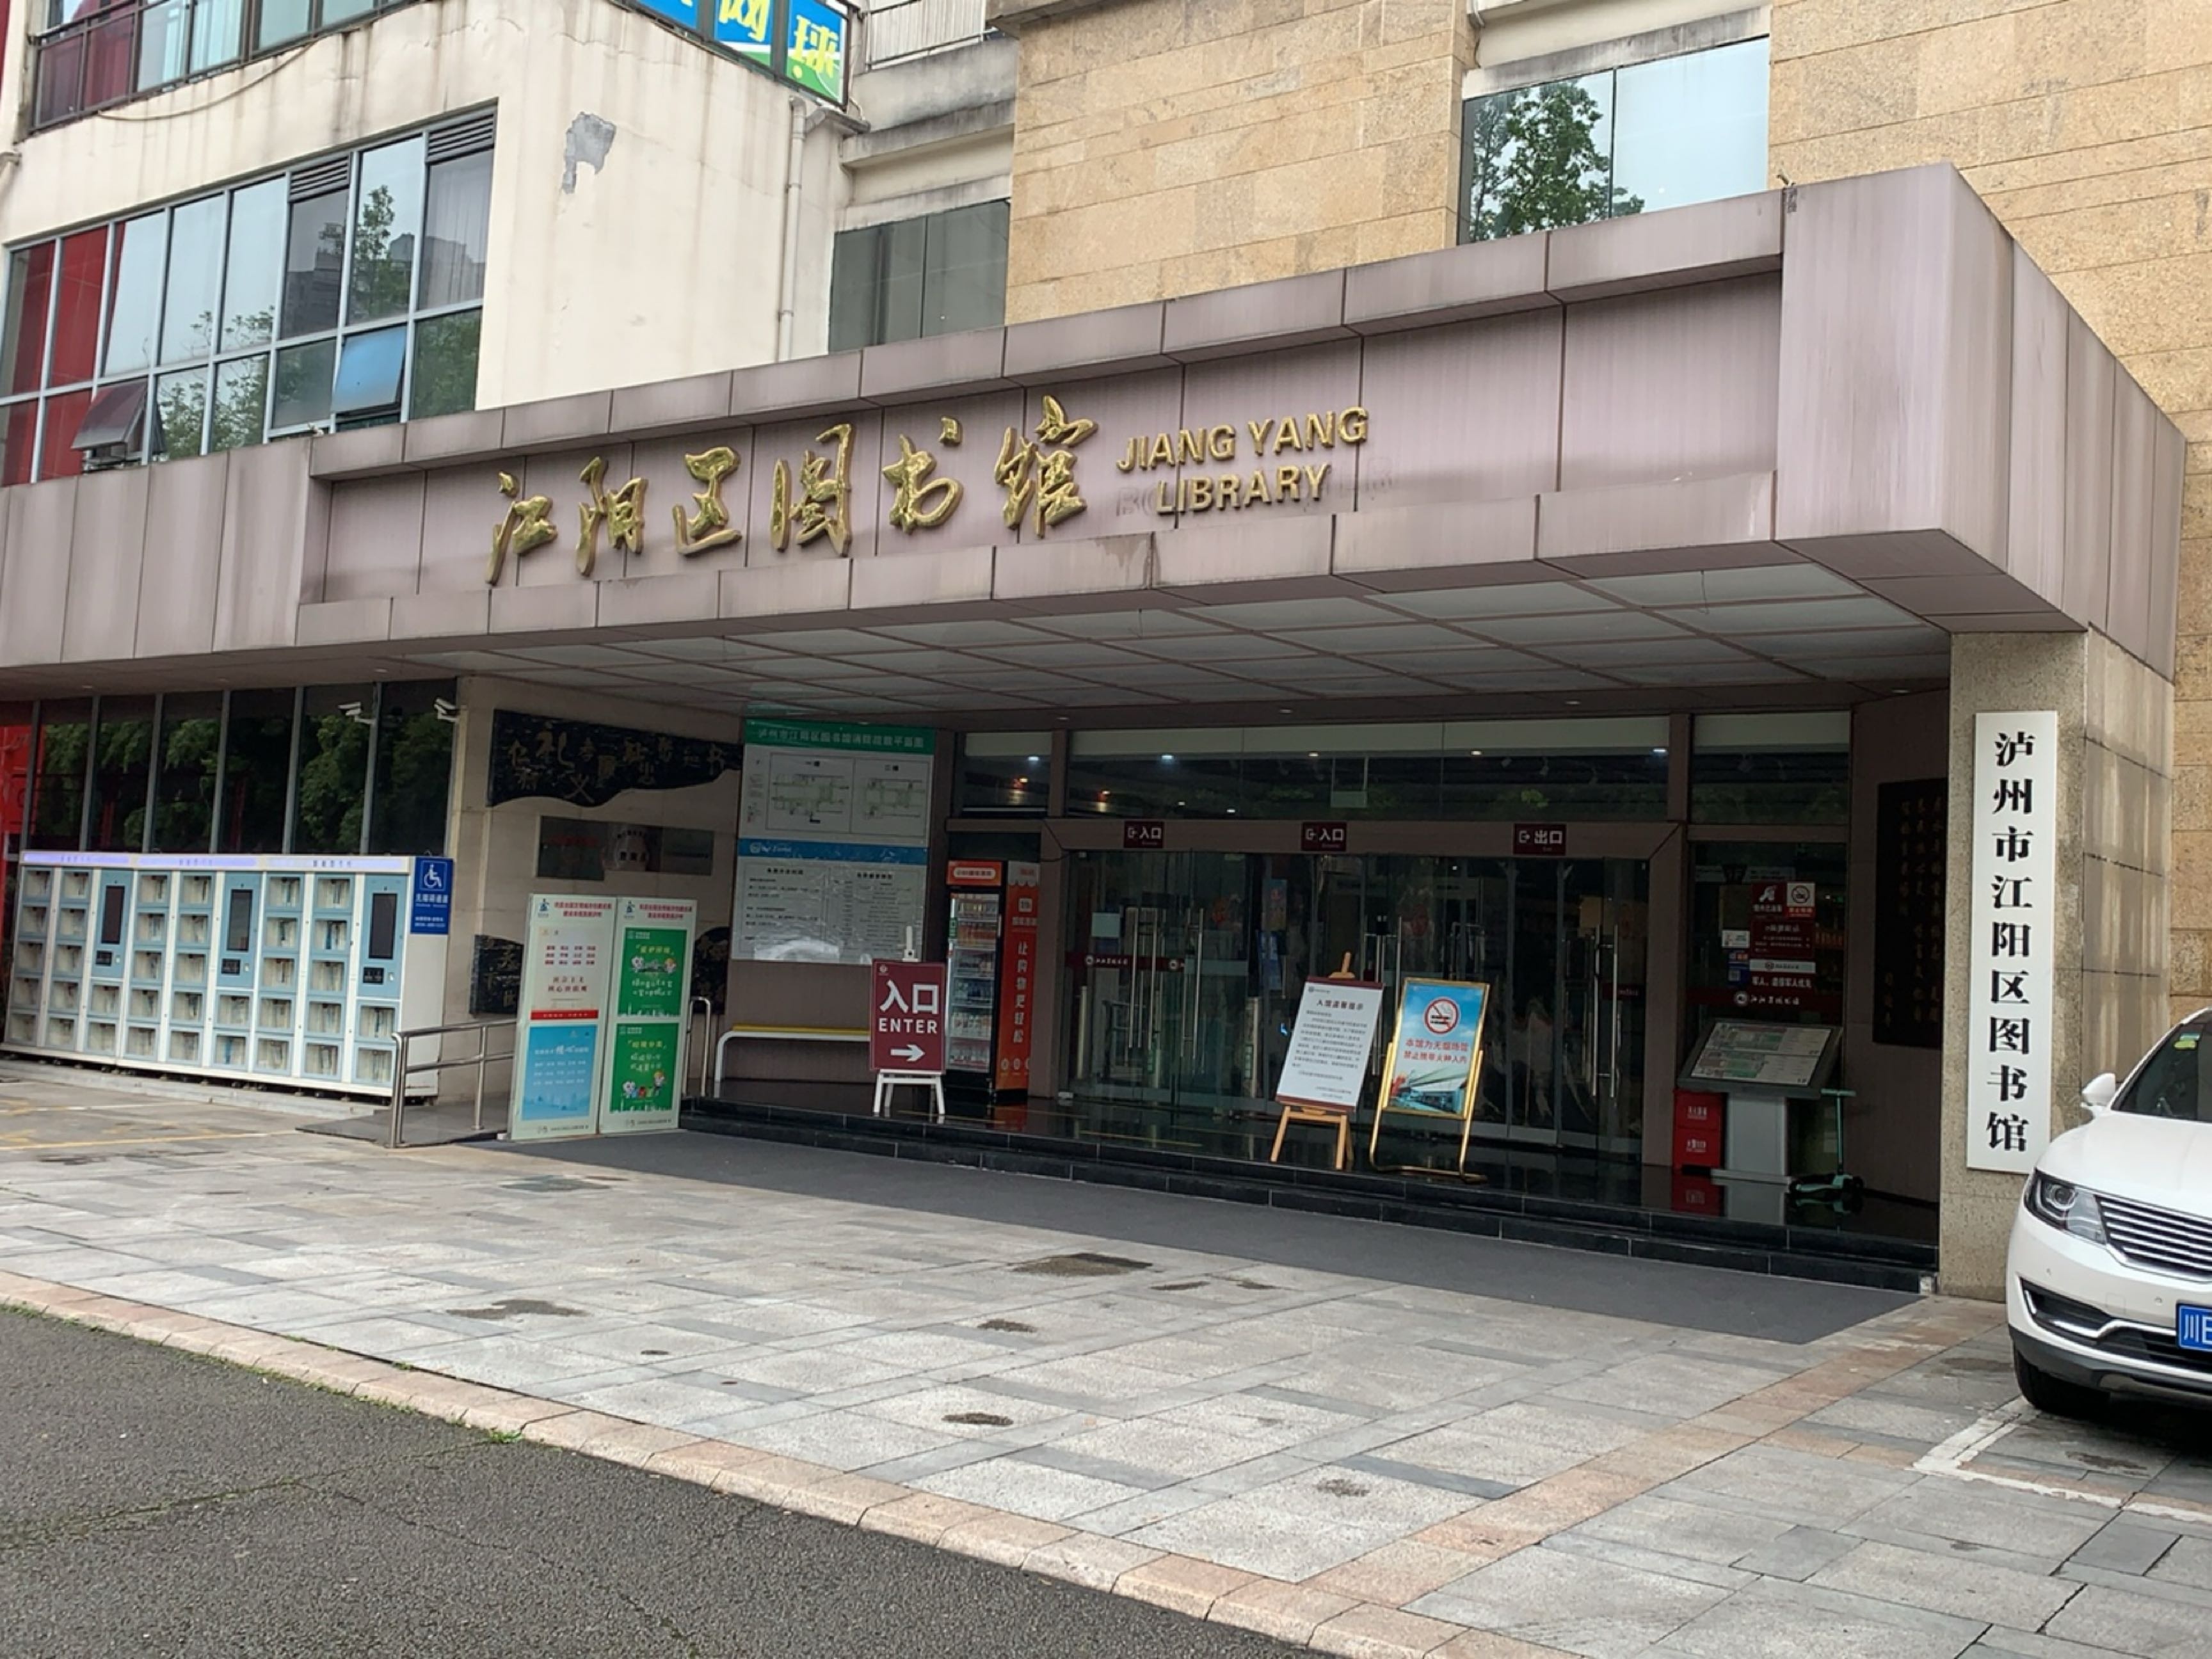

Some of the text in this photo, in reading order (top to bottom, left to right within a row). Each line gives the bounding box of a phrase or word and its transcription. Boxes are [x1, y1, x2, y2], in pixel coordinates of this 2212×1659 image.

[680, 0, 839, 78] 网球
[1116, 406, 1368, 472] JIANG YANG
[1156, 462, 1331, 515] LIBRARY
[1139, 826, 1162, 840] 入口
[1319, 828, 1345, 842] 入口
[1534, 830, 1563, 844] 出口
[1986, 732, 2037, 1152] 泸州市江阳区图书馆
[879, 979, 940, 1015] 入口
[878, 1018, 938, 1034] ENTER
